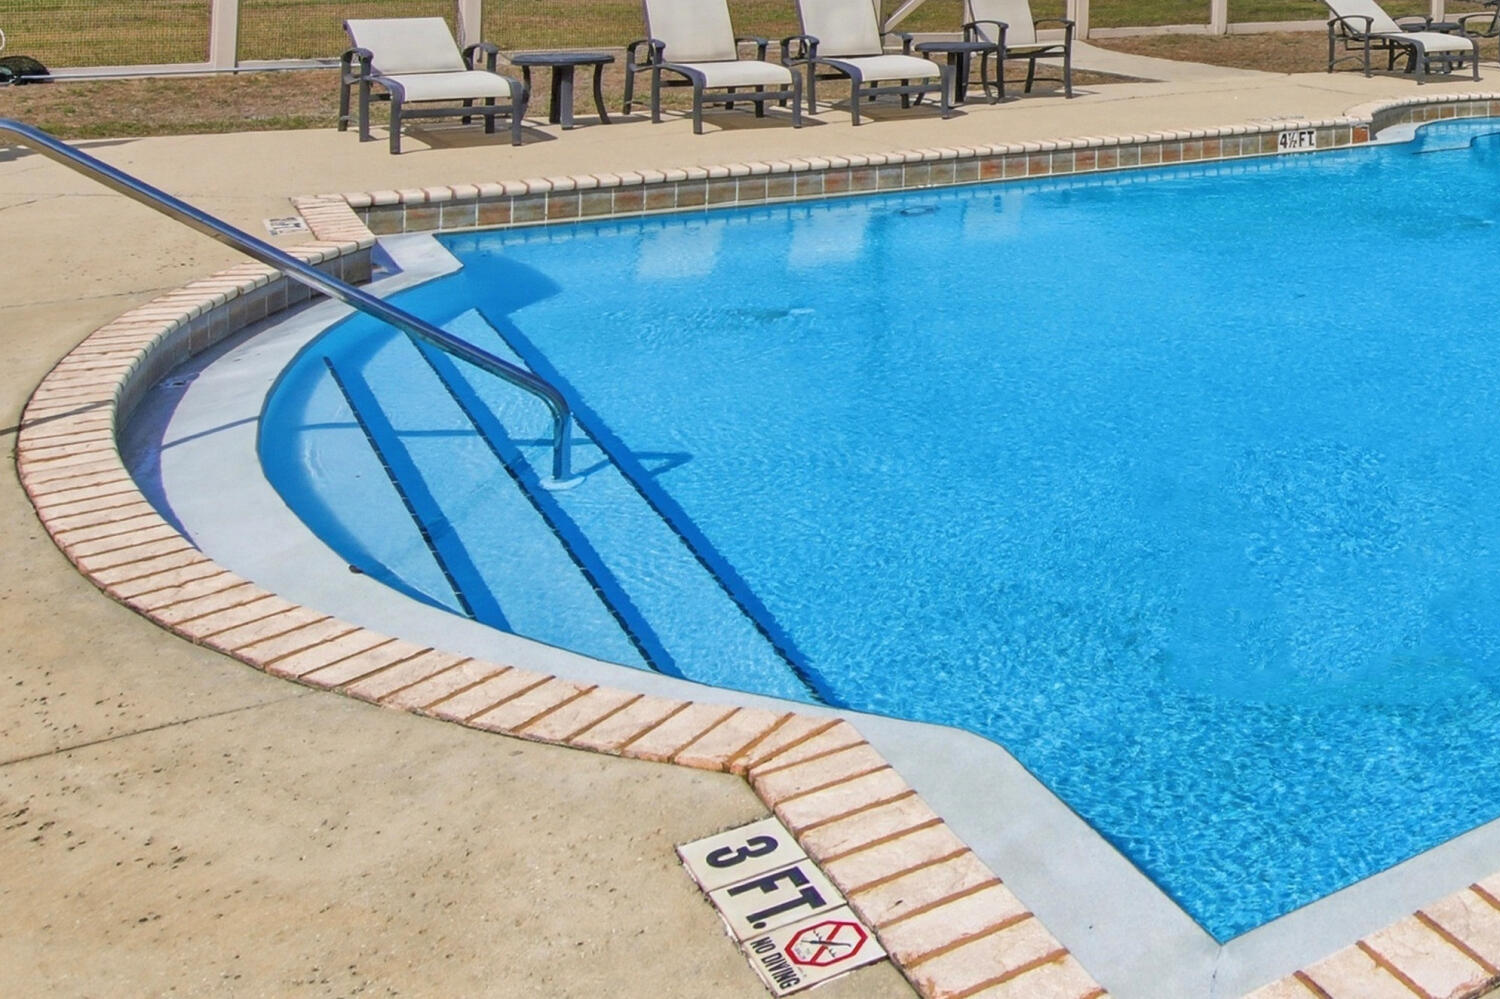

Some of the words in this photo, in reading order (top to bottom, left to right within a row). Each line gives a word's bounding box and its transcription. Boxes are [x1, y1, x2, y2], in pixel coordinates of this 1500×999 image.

[706, 835, 779, 869] 3
[727, 866, 827, 930] FT.
[750, 936, 776, 954] NO
[760, 951, 801, 990] DIVING
